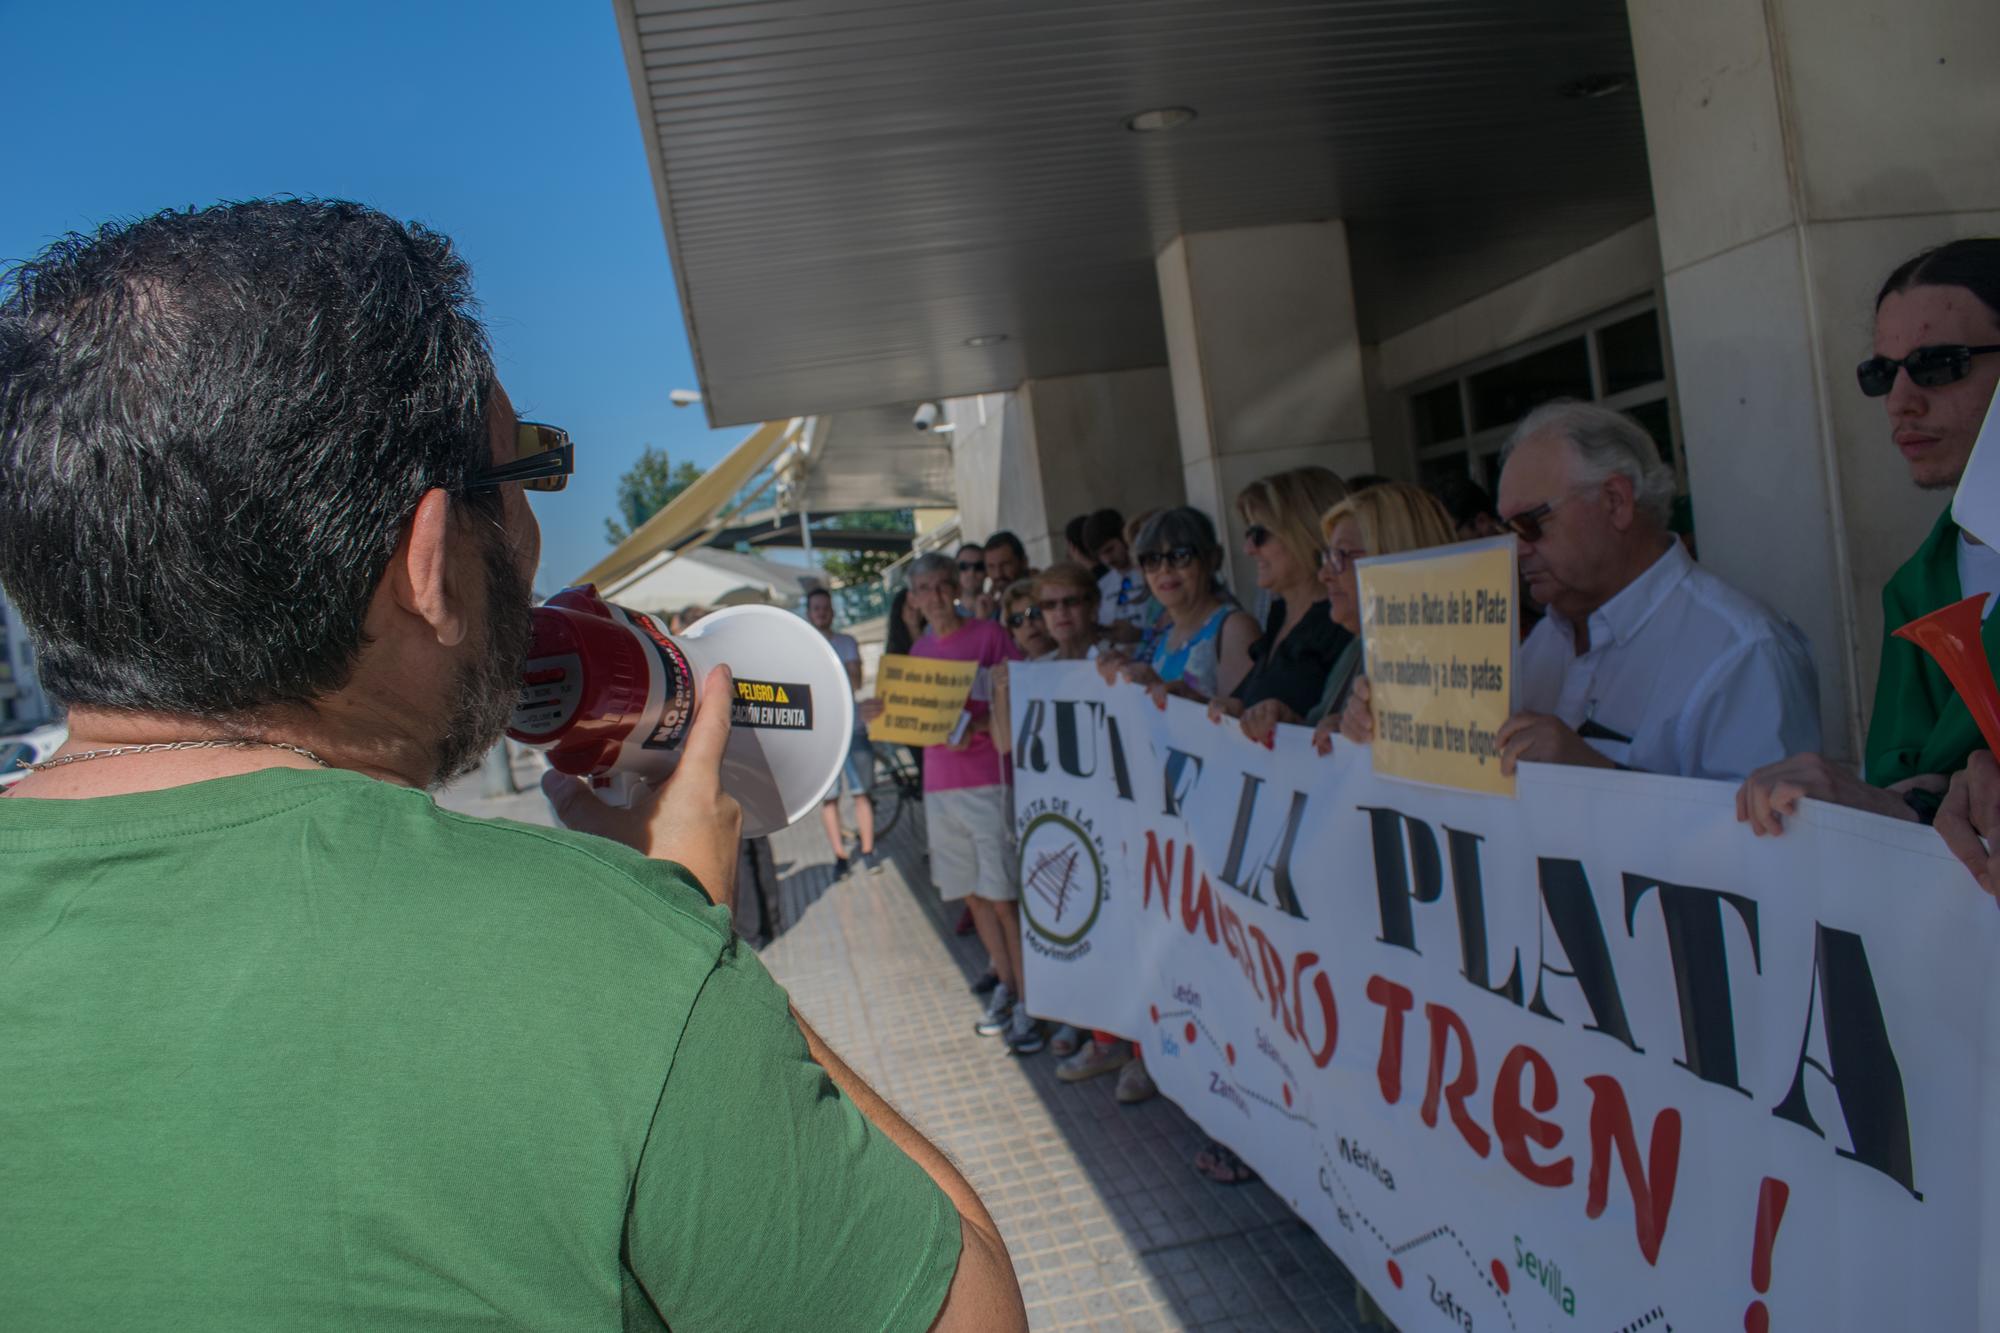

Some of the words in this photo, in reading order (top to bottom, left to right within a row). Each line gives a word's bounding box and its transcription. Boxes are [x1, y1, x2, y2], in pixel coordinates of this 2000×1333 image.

[1421, 591, 1444, 626] Ruta
[1447, 591, 1459, 625] de
[1462, 589, 1473, 625] la
[1475, 588, 1507, 625] Plata
[737, 682, 774, 702] PELIGRO
[1442, 663, 1448, 688] a
[1451, 654, 1468, 690] dos
[1471, 656, 1504, 699] patas
[653, 709, 679, 742] NO
[761, 706, 774, 725] EN
[775, 707, 805, 727] VENTA
[1052, 796, 1070, 814] DE
[1075, 807, 1095, 833] LA
[1356, 805, 1924, 1203] PLATA
[1513, 1234, 1576, 1317] Sevilla
